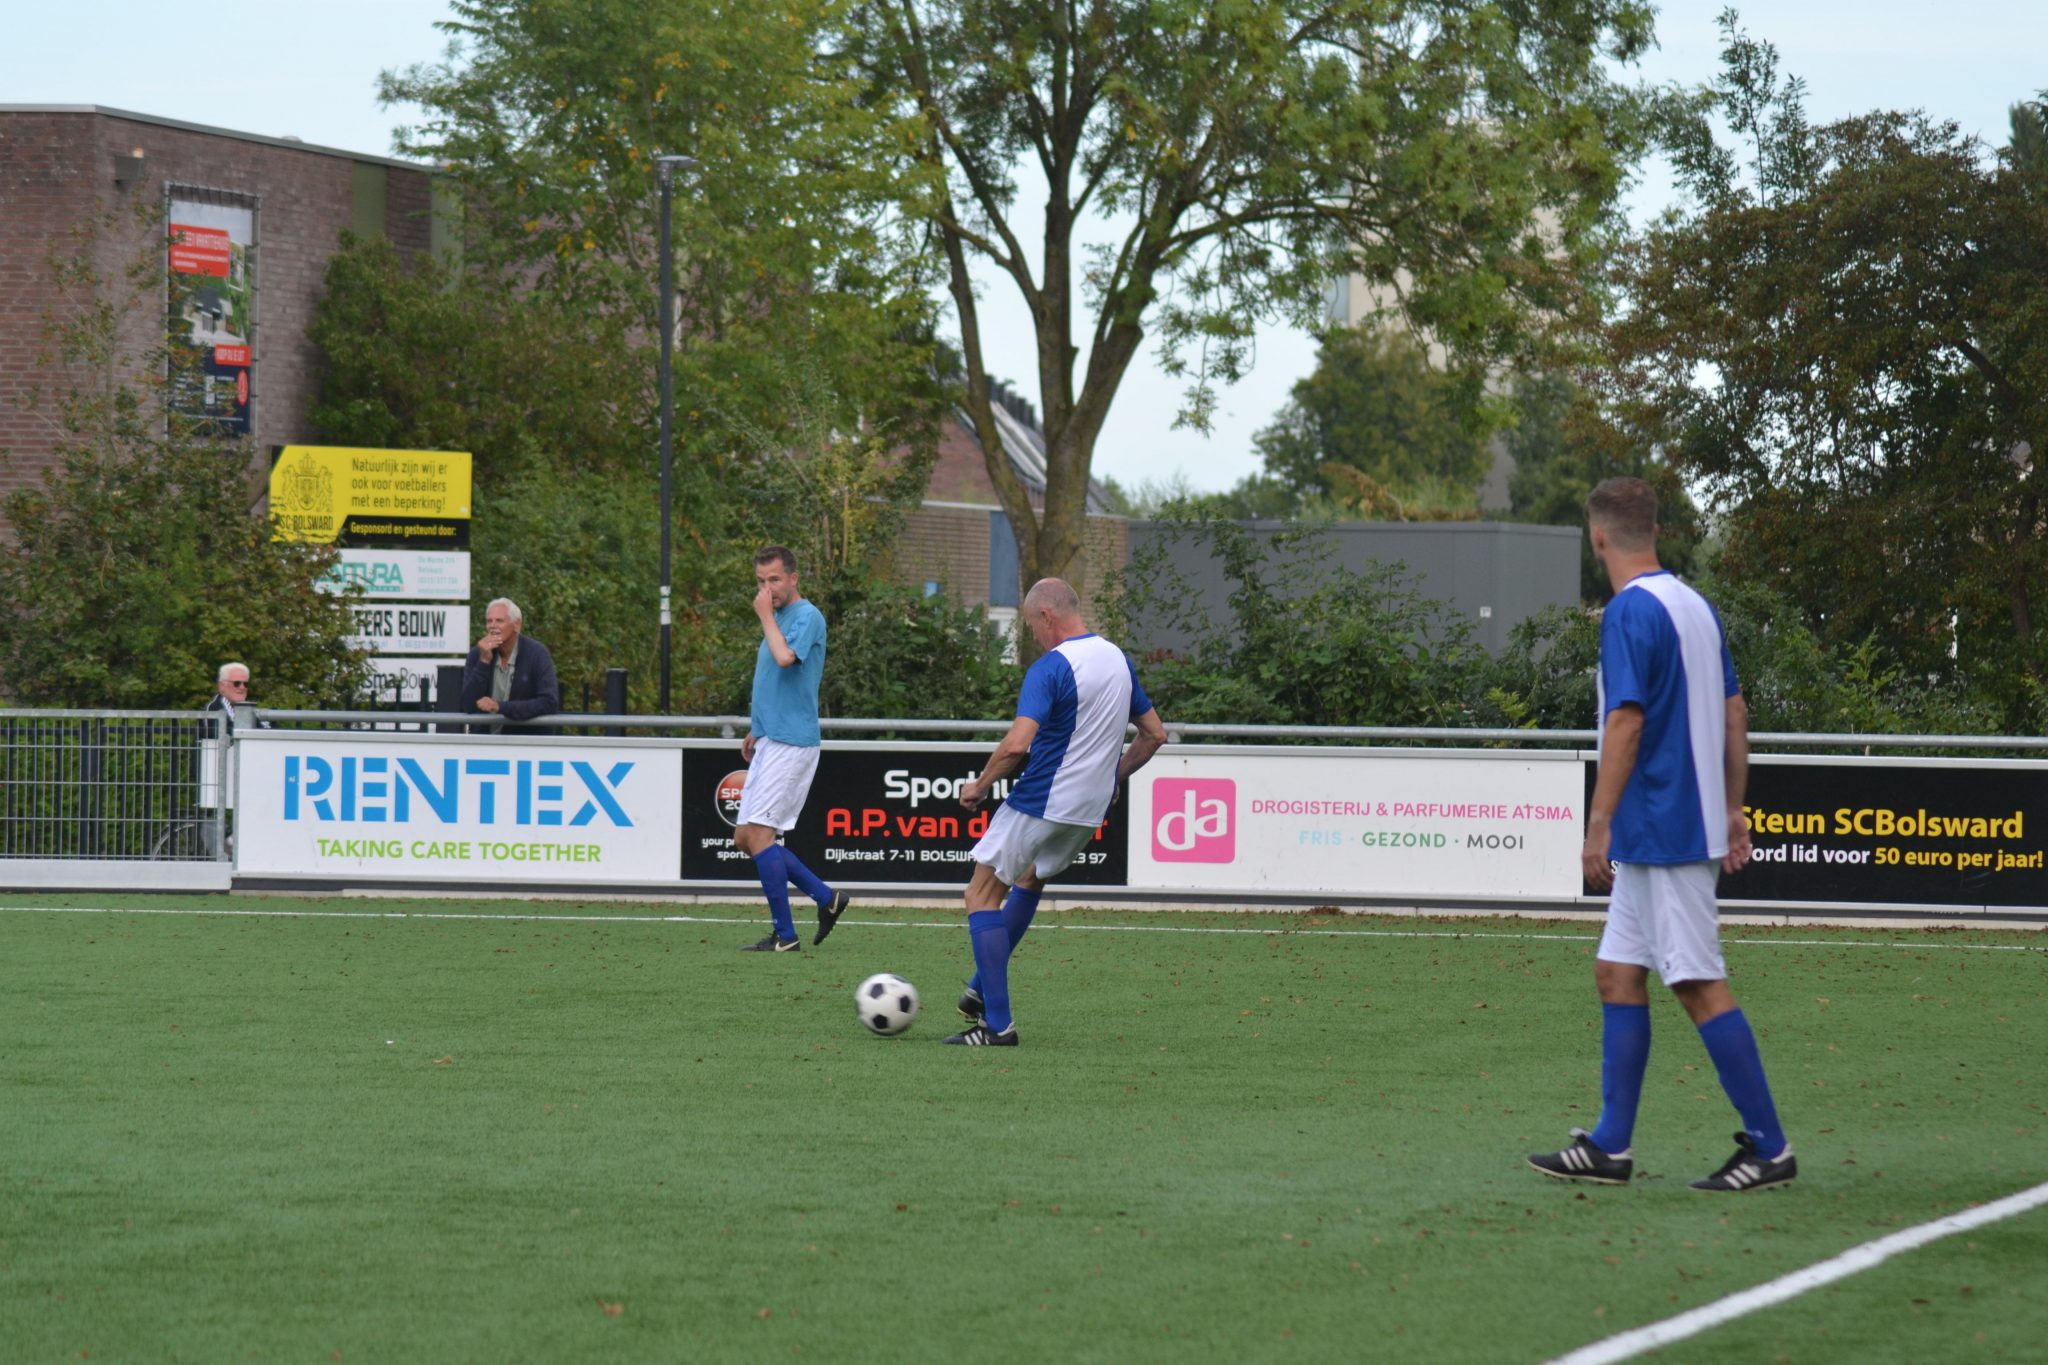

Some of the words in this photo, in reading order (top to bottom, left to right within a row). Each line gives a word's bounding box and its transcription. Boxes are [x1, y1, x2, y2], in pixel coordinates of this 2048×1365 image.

[352, 457, 399, 477] Natuurlijk
[401, 460, 419, 477] zijn
[421, 460, 436, 478] wij
[438, 463, 448, 475] er
[352, 476, 369, 490] ook
[371, 479, 392, 491] voor
[395, 478, 447, 493] voetballers
[352, 494, 371, 508] met
[373, 496, 391, 508] een
[394, 495, 446, 514] beperking!
[293, 515, 334, 531] BOLSWARD
[351, 521, 392, 536] Gesponsord
[393, 524, 403, 535] en
[404, 524, 437, 538] gesteund
[398, 610, 446, 637] BOUW
[284, 755, 637, 827] RENTEX
[1251, 800, 1370, 816] DROGISTERIJ
[1376, 802, 1389, 816] &
[1394, 803, 1507, 819] PARFUMERIE
[1512, 805, 1573, 820] ATSMA
[827, 808, 891, 837] A.P.
[896, 816, 958, 838] van
[1157, 790, 1228, 851] da
[1834, 808, 2023, 838] SCBolsward
[702, 838, 724, 848] your
[1299, 831, 1342, 846] FRIS
[1362, 832, 1446, 848] GEZOND
[1467, 834, 1523, 849] MOOI
[317, 839, 403, 859] TAKING
[410, 841, 471, 859] CARE
[478, 842, 601, 862] TOGETHER
[825, 849, 885, 862] Dijkstraat
[889, 850, 915, 861] 7-11
[921, 851, 977, 862] BOLSWA
[1089, 853, 1107, 864] 97
[1748, 844, 1787, 862] ord
[1792, 845, 1818, 863] lid
[1823, 849, 1871, 864] voor
[1874, 848, 1900, 865] 50
[1904, 851, 1953, 866] euro
[1957, 852, 1993, 871] per
[1995, 850, 2044, 872] jaar!
